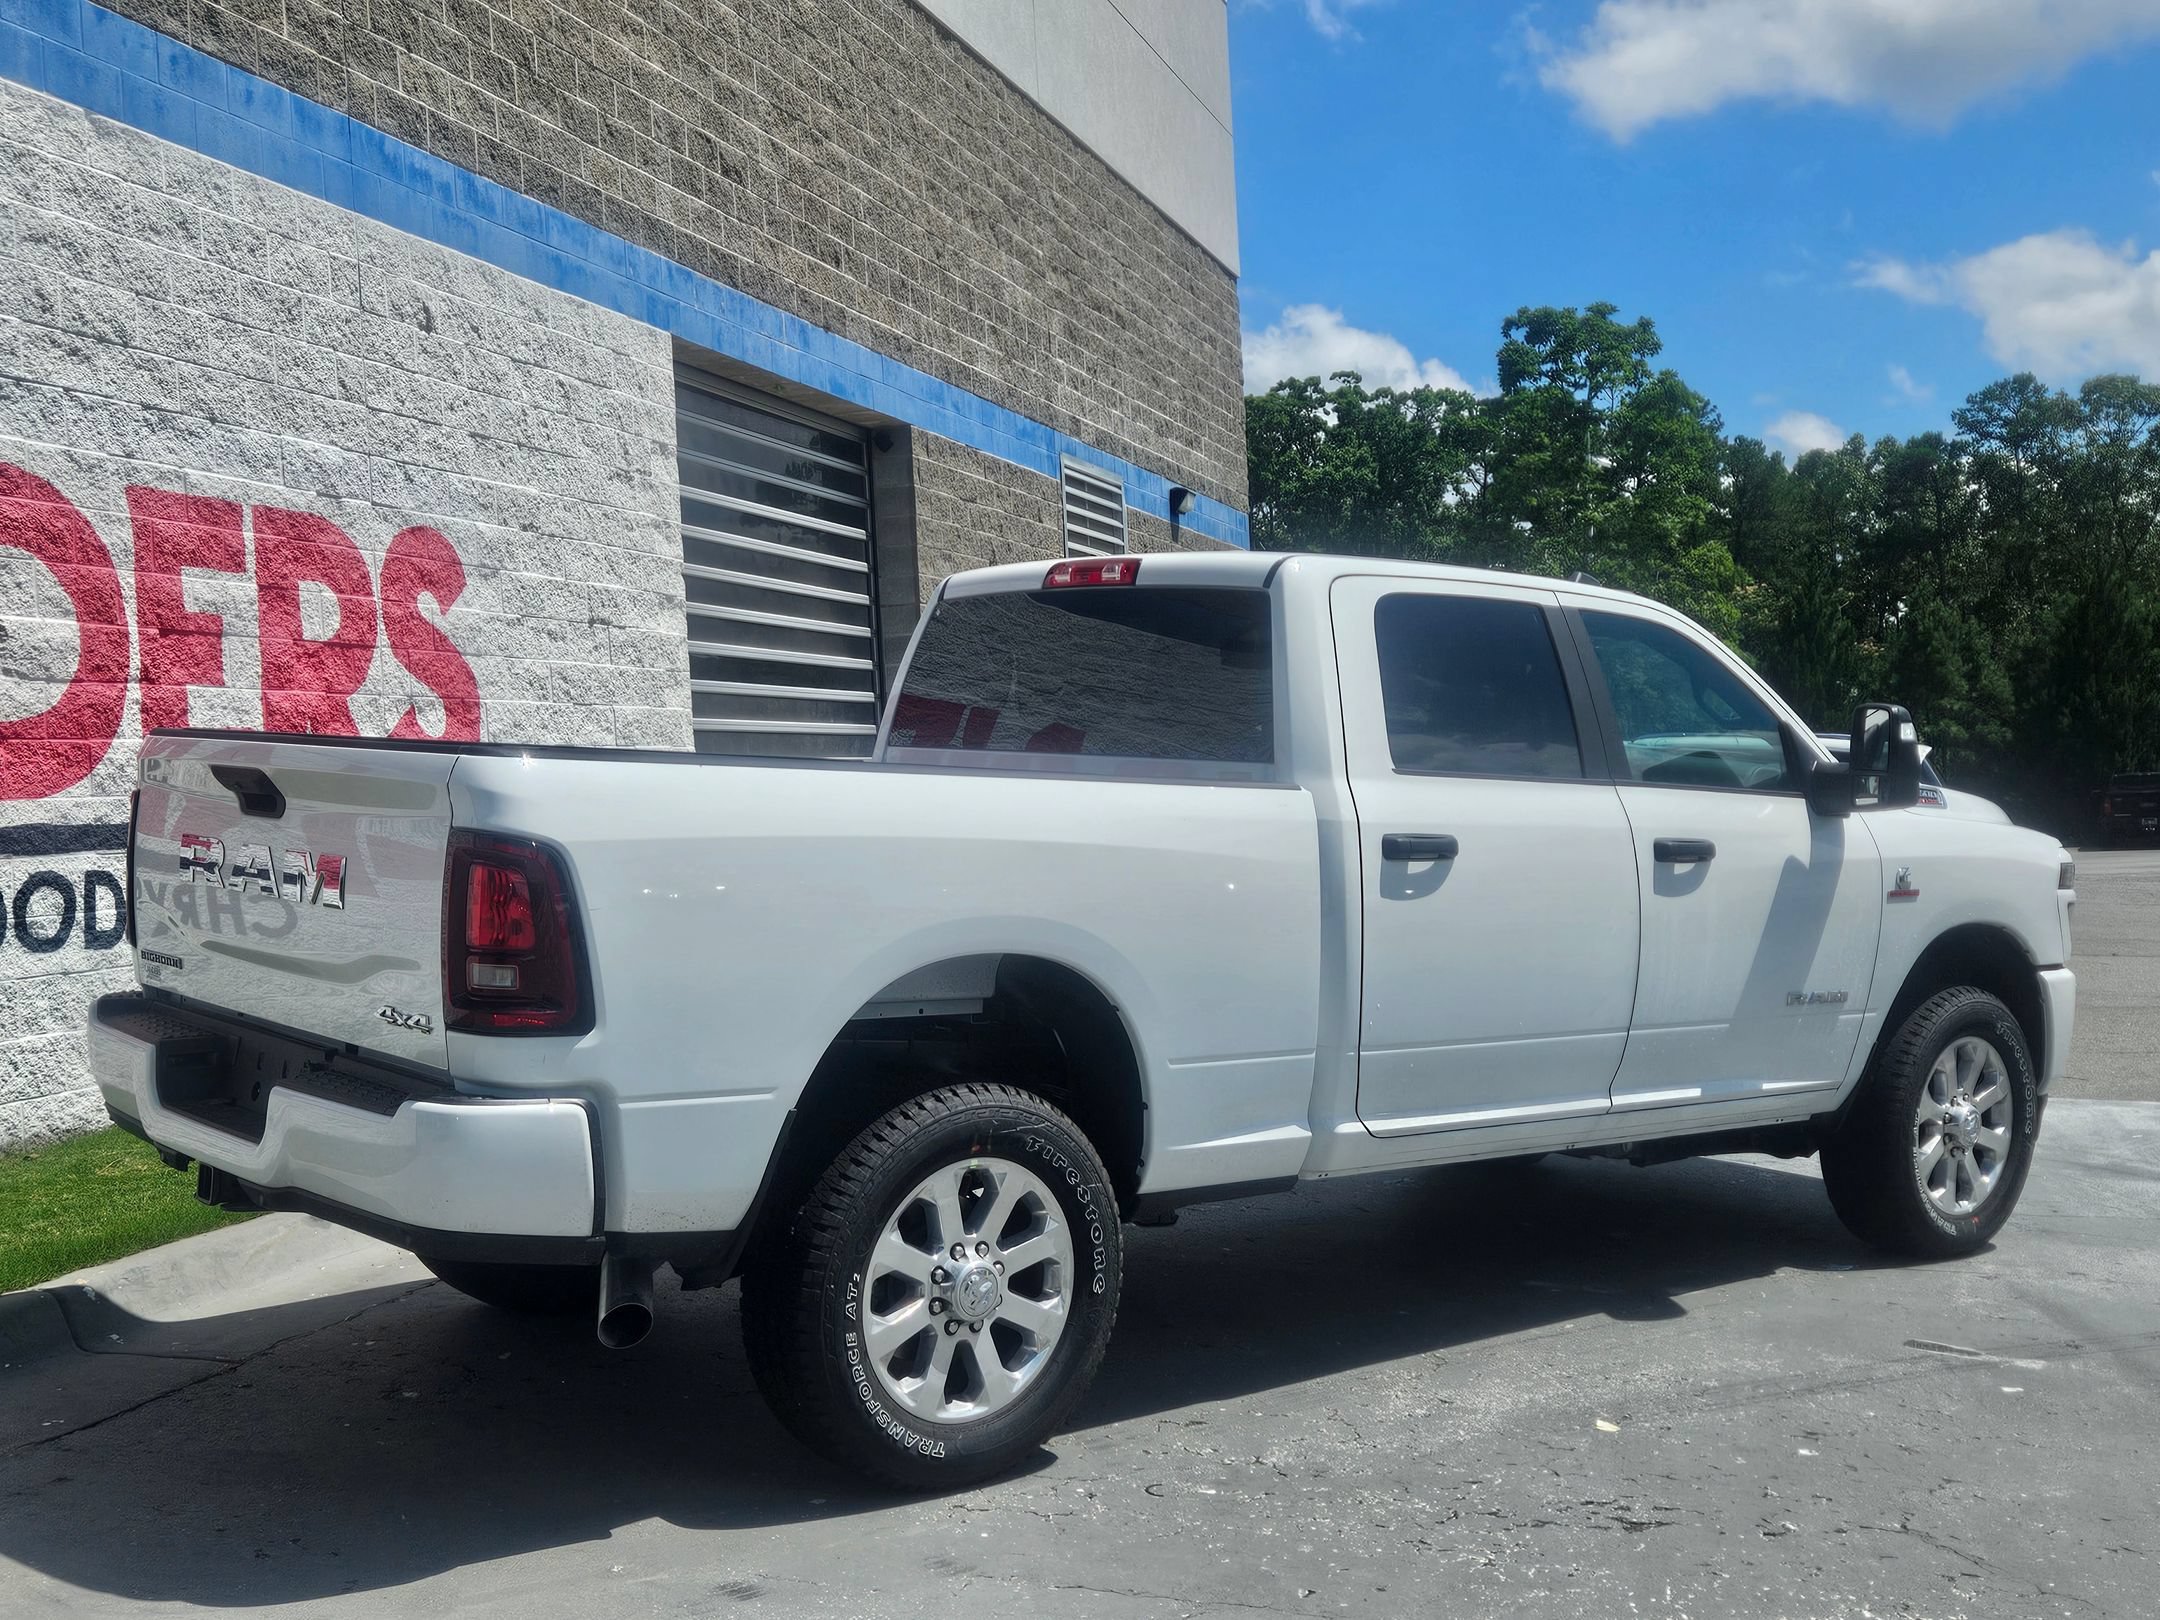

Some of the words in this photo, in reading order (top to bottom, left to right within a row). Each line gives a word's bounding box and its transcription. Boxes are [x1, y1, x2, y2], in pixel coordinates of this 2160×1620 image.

[0, 869, 127, 953] OD
[179, 833, 347, 909] RAM
[1787, 990, 1849, 1007] RAM
[844, 1333, 946, 1459] TRANSFORCE
